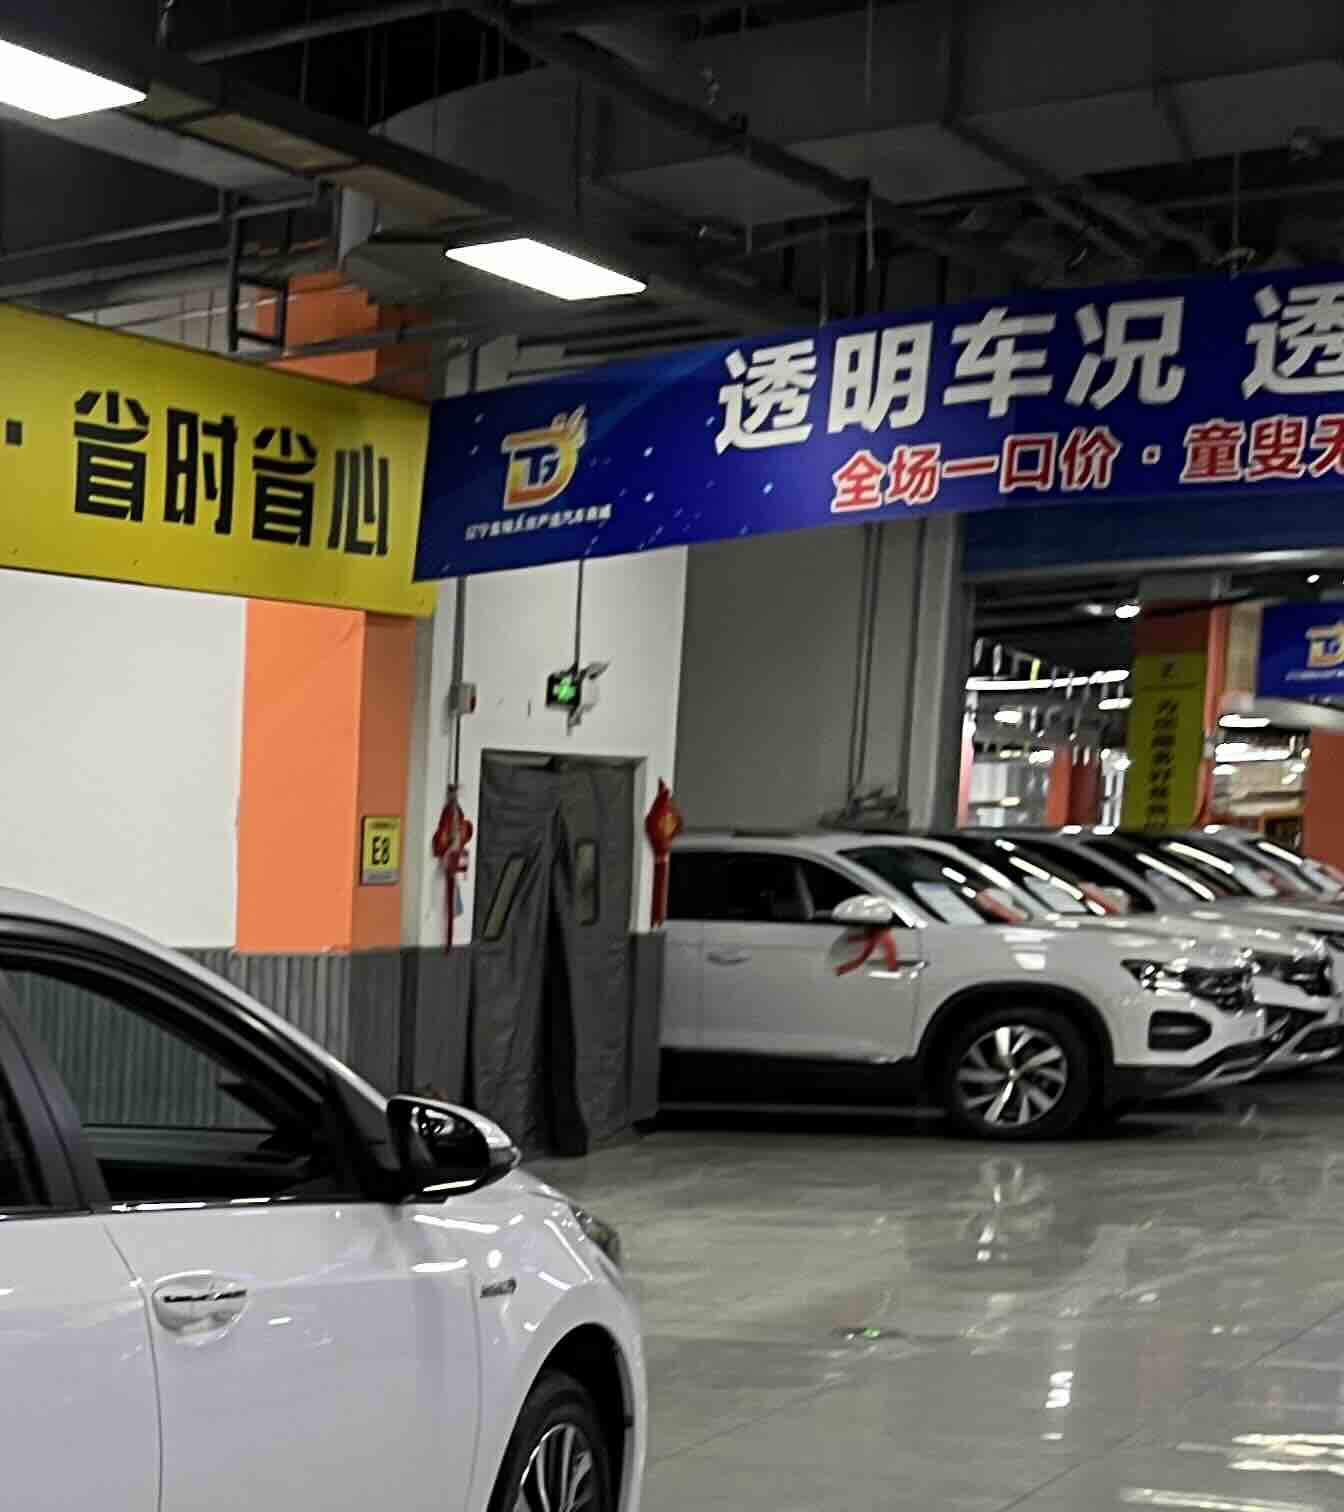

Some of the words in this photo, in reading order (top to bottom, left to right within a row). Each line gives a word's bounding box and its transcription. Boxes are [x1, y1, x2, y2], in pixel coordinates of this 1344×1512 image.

[714, 296, 1186, 455] 透明车况
[1242, 281, 1344, 401] 透
